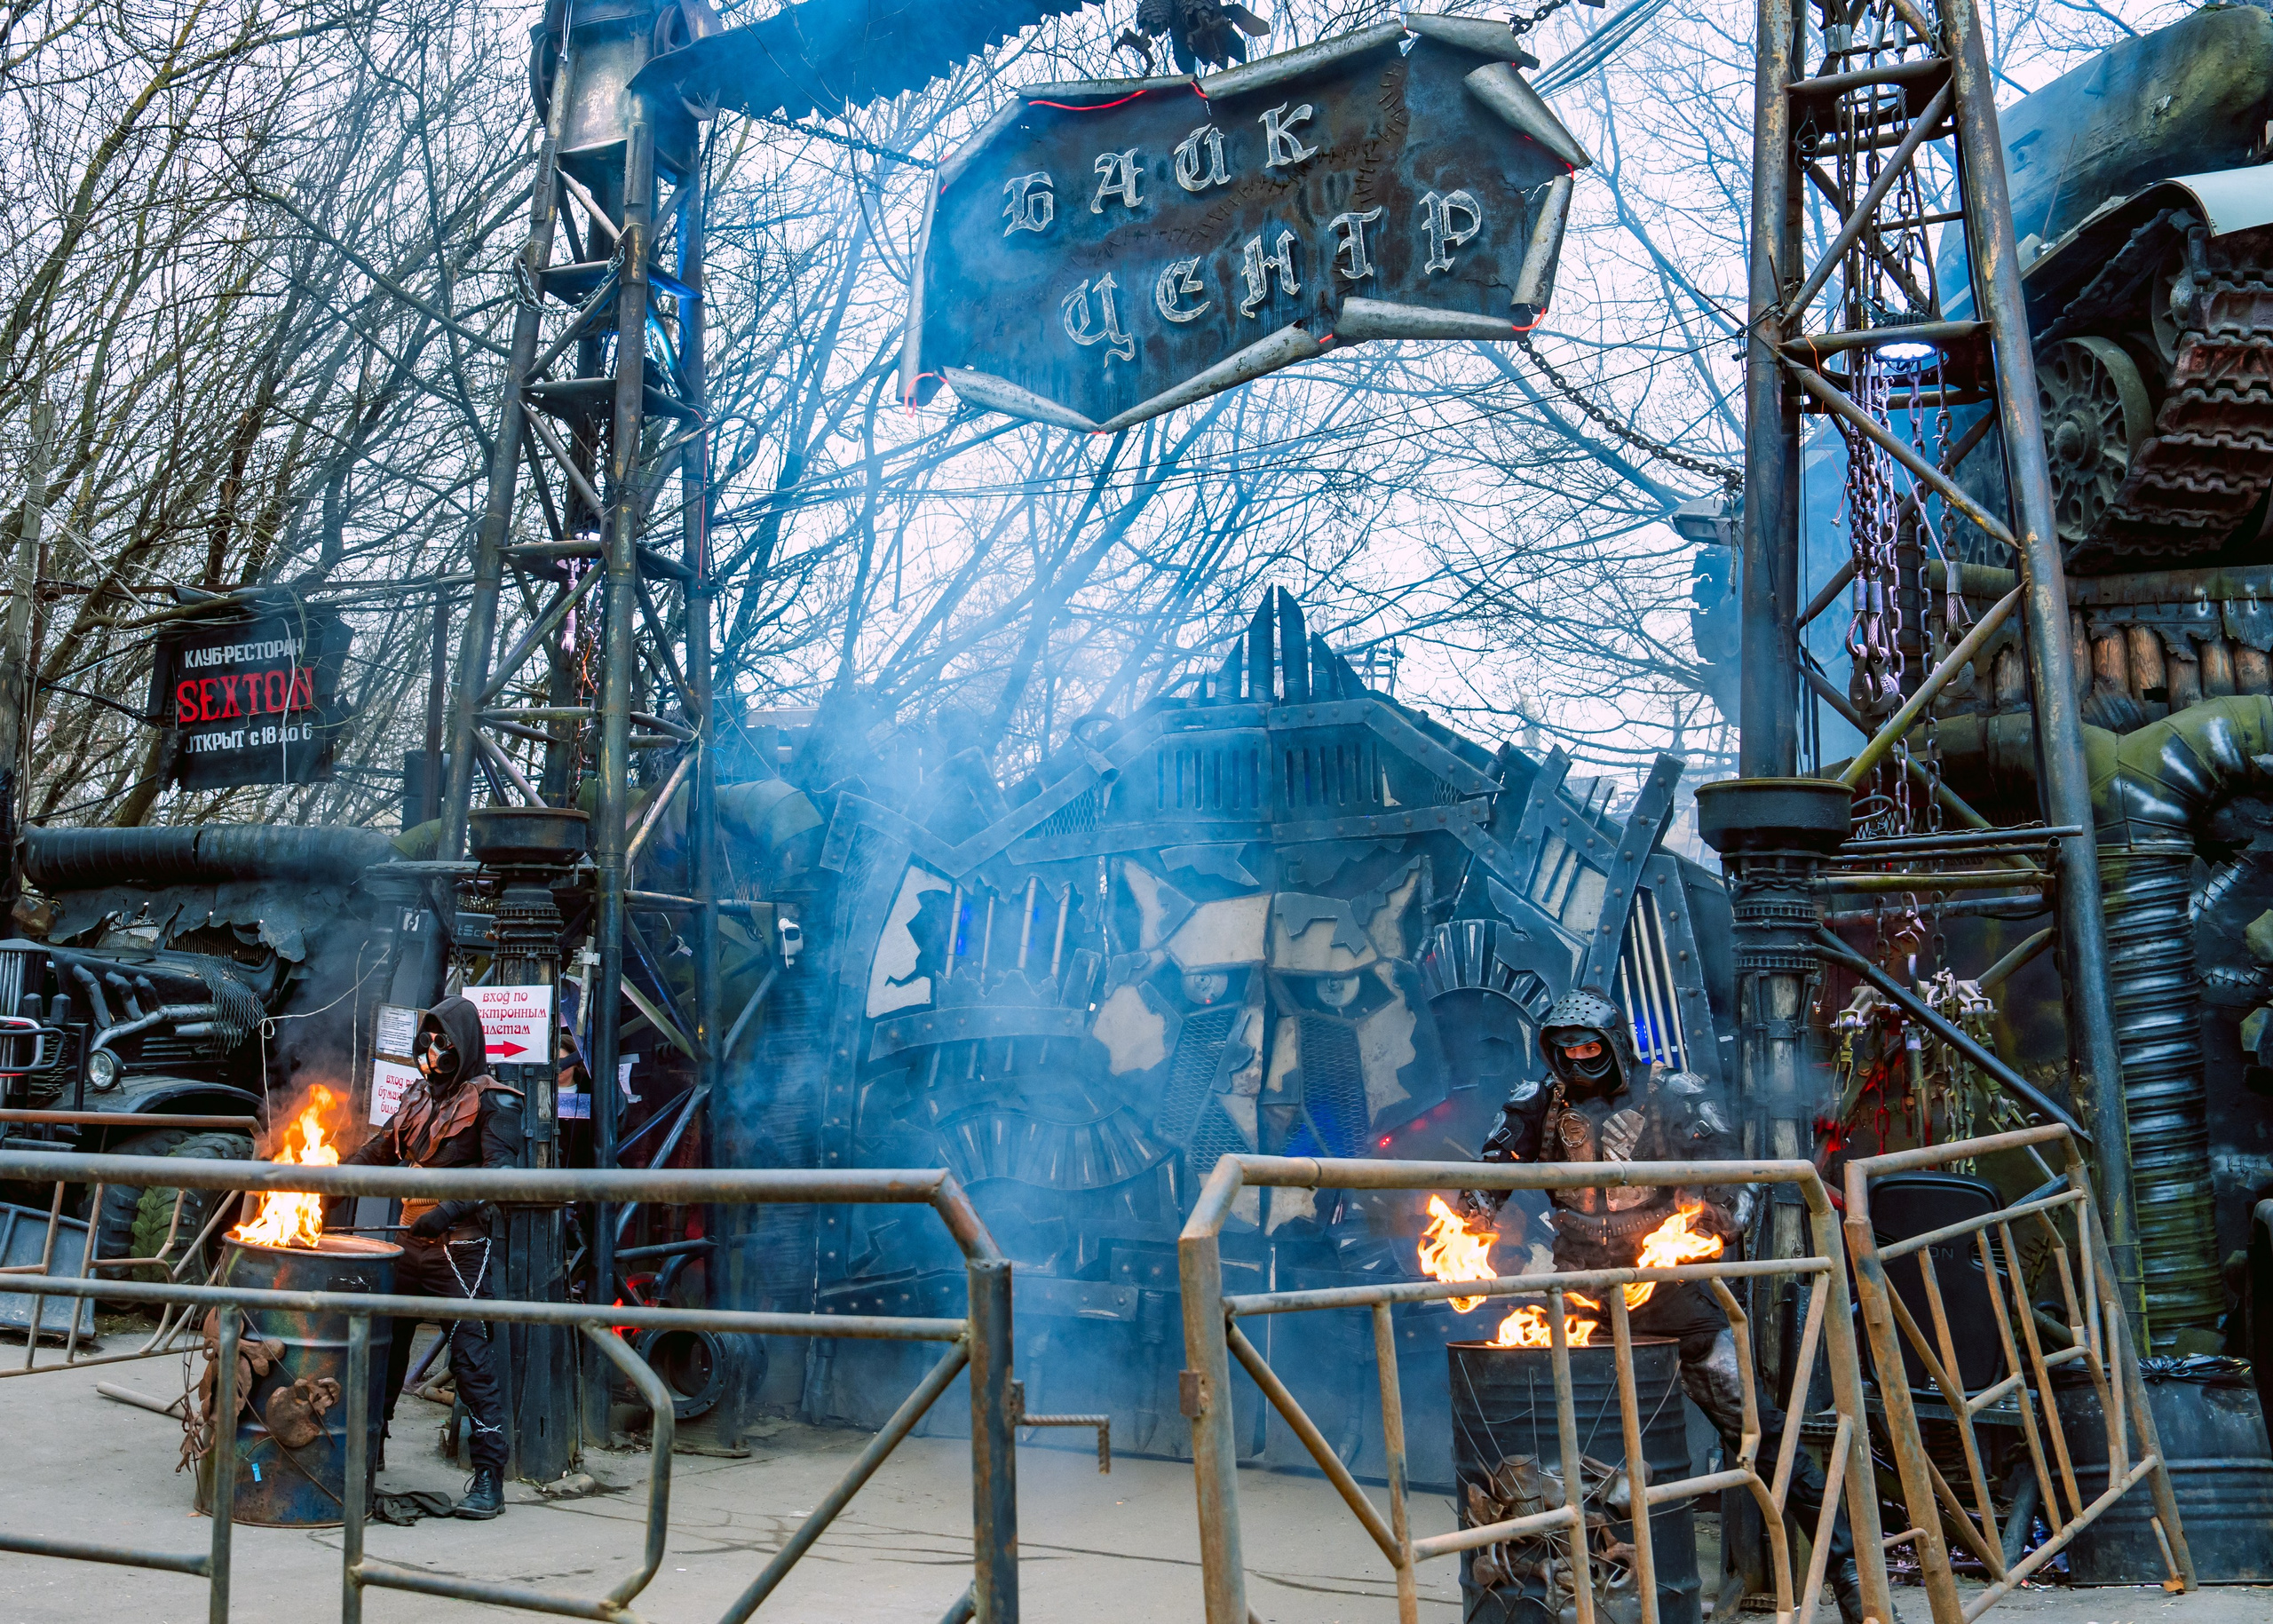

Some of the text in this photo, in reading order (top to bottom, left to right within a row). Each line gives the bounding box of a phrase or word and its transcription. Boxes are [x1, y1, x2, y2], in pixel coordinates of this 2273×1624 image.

[1060, 188, 1482, 368] ЦЕНТР
[184, 638, 303, 669] КЛУБ-РЕСТОРАН
[177, 667, 313, 724] SEXTON
[261, 725, 276, 745] 18
[482, 992, 528, 1004] вход по
[478, 1008, 547, 1021] ектронным
[482, 1025, 531, 1035] илетам
[385, 1074, 404, 1089] вход
